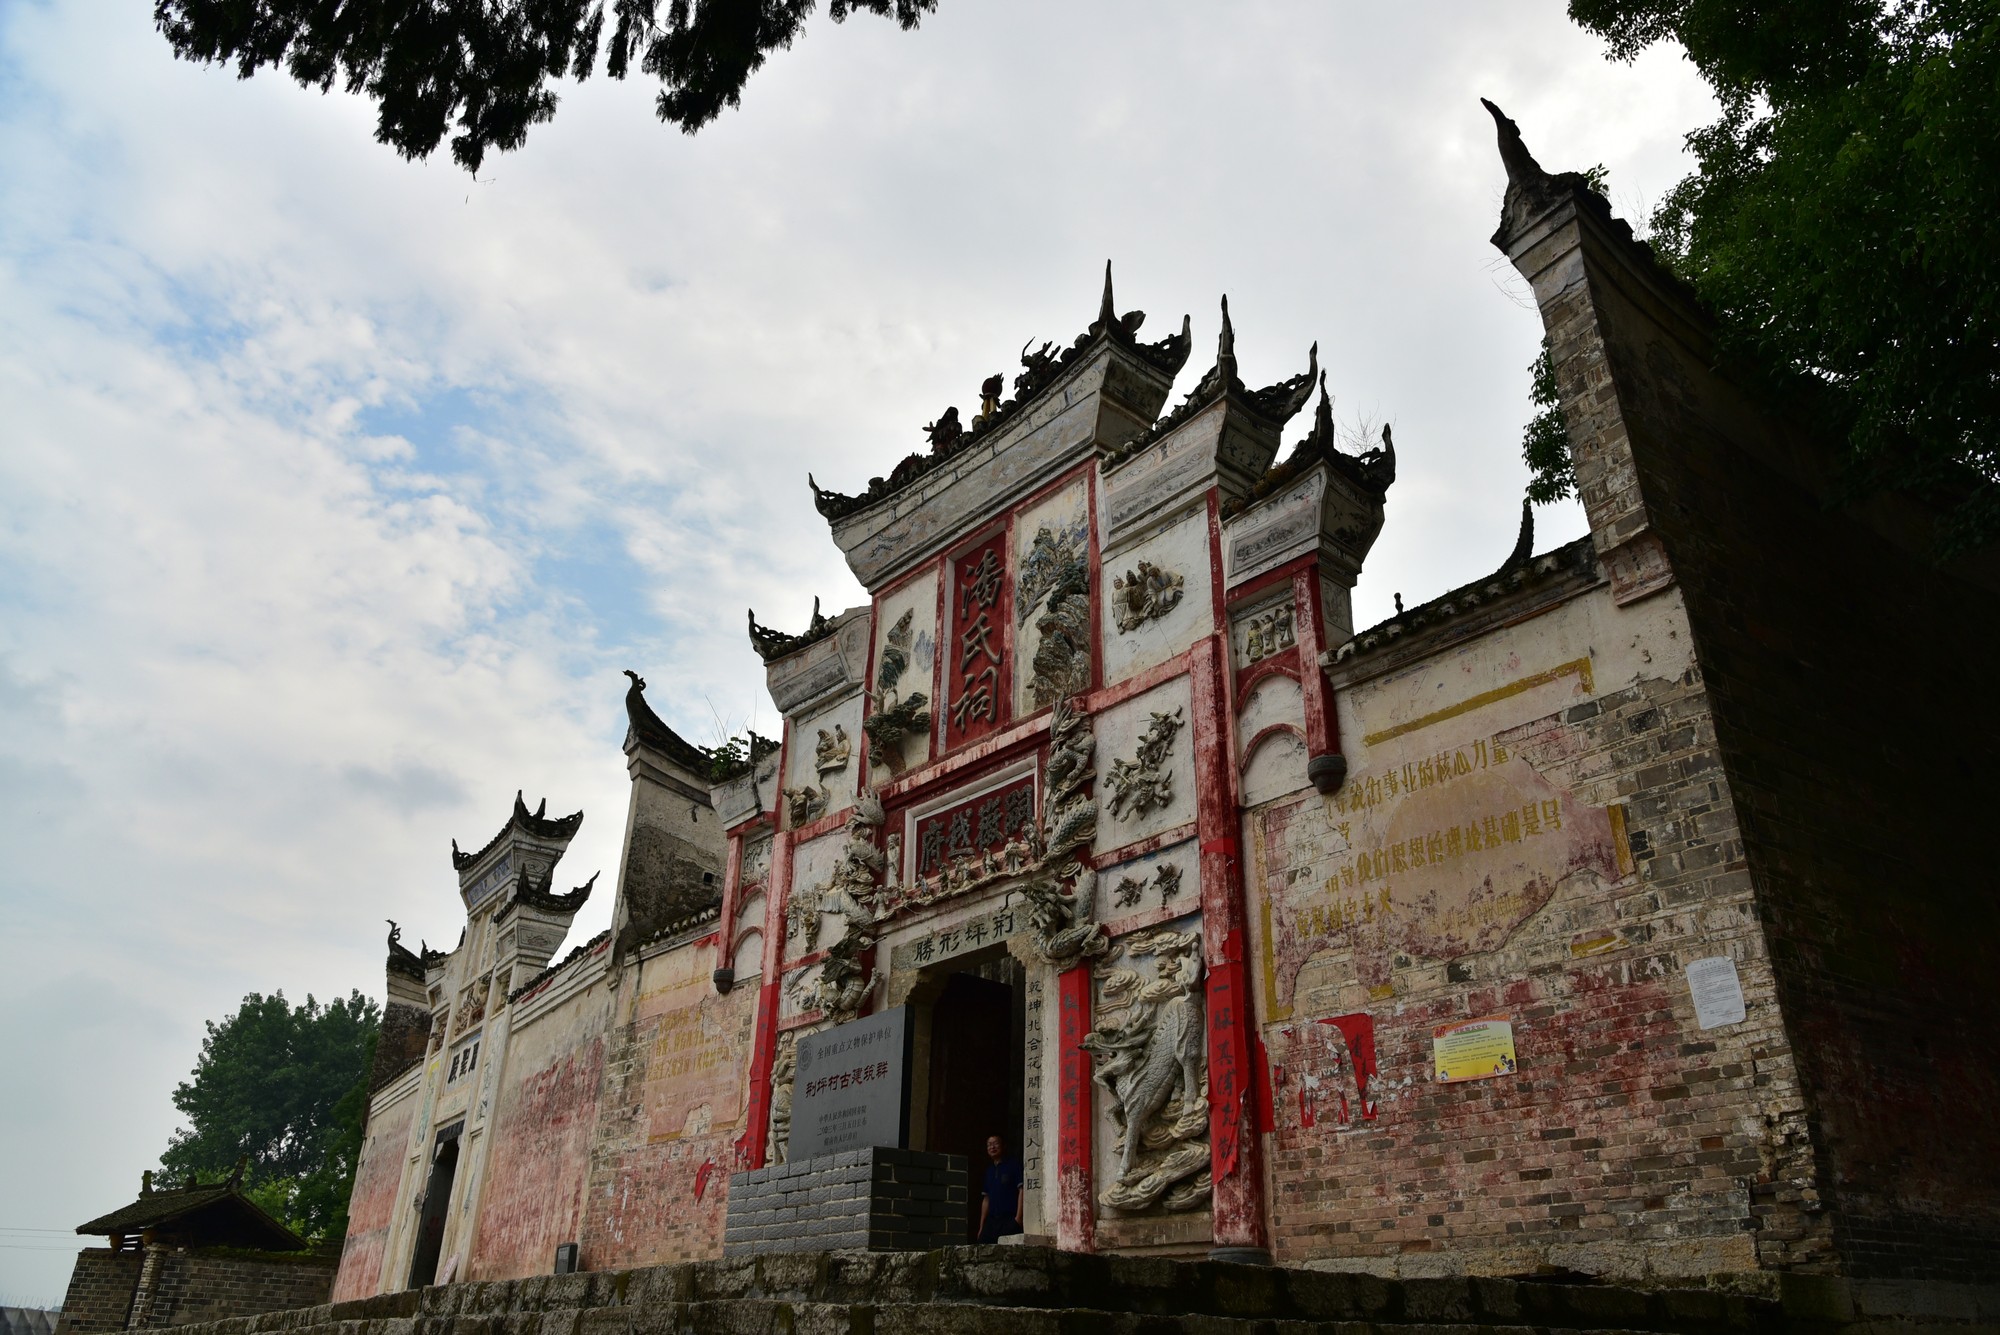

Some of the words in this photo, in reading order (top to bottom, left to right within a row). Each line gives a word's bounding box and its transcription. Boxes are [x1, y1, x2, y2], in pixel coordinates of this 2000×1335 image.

[951, 548, 1004, 734] 潘氏祠
[817, 1026, 892, 1060] 全国重点文物保护单位
[805, 1061, 889, 1098] 荆坪村古建筑群
